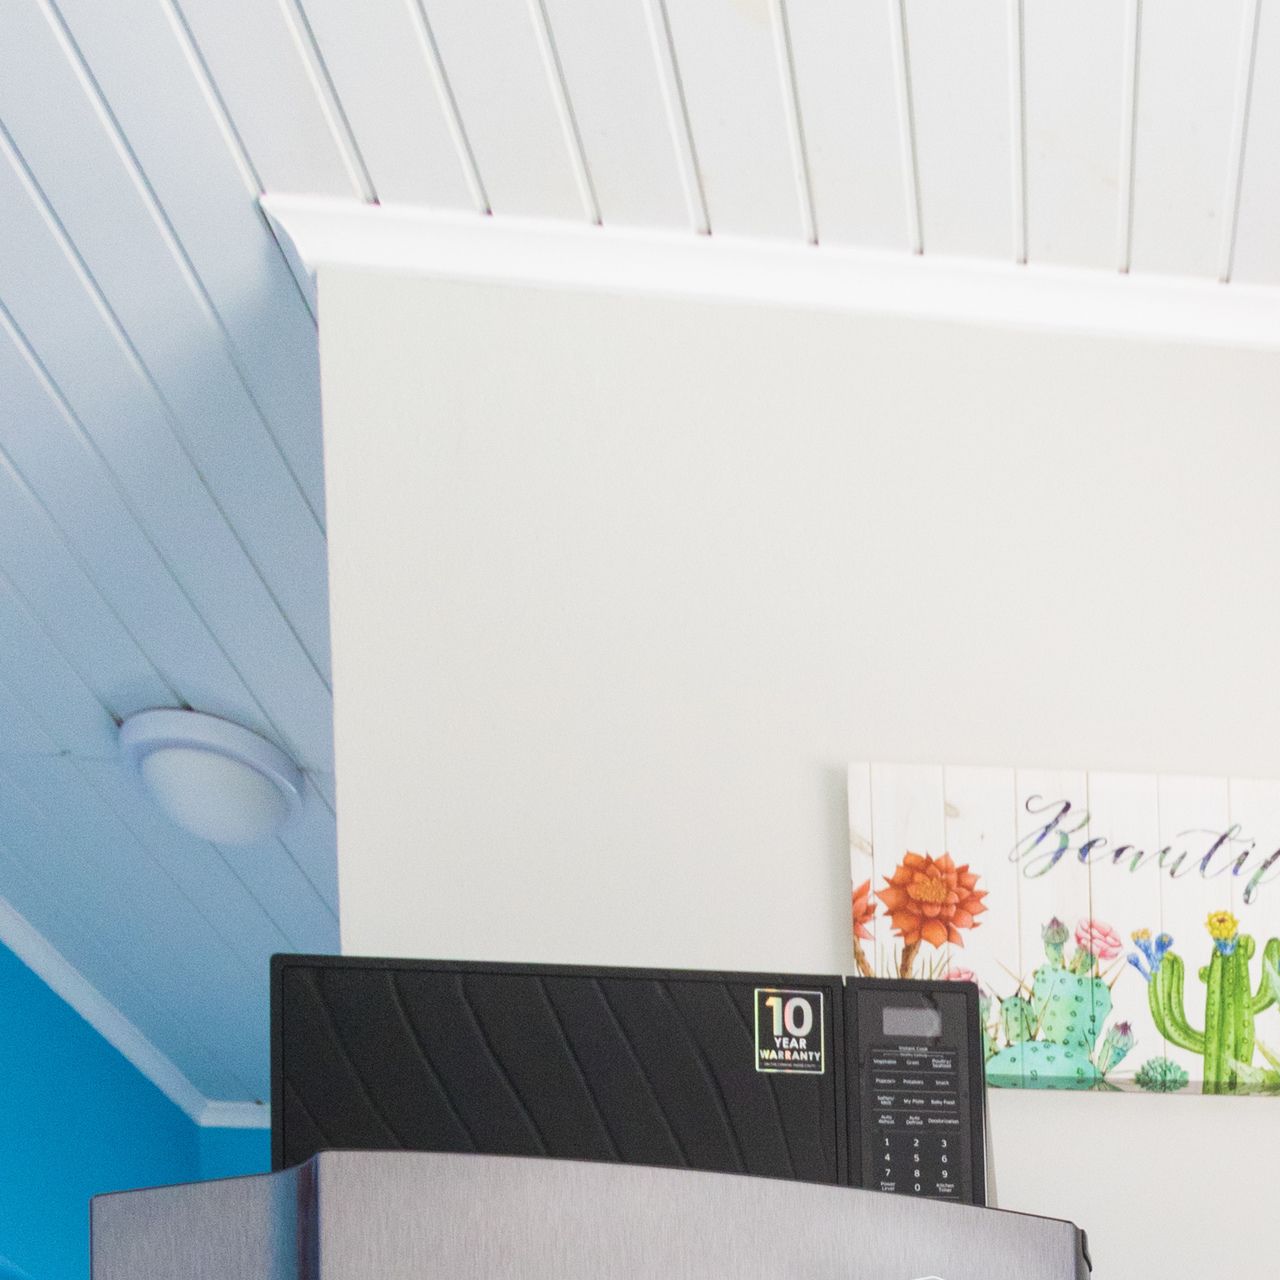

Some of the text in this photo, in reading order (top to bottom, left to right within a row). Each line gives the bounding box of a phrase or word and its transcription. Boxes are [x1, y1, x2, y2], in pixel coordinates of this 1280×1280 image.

[765, 996, 813, 1037] 10
[774, 1037, 807, 1049] YEAR
[759, 1049, 821, 1061] WARRANTY
[884, 1137, 890, 1147] 1
[913, 1138, 920, 1148] 2
[941, 1138, 948, 1149] 3
[884, 1153, 891, 1162] 4
[913, 1153, 921, 1163] 5
[941, 1154, 949, 1164] 6
[885, 1168, 892, 1178] 7
[914, 1168, 921, 1179] 8
[941, 1169, 949, 1179] 9
[914, 1183, 921, 1193] 0
